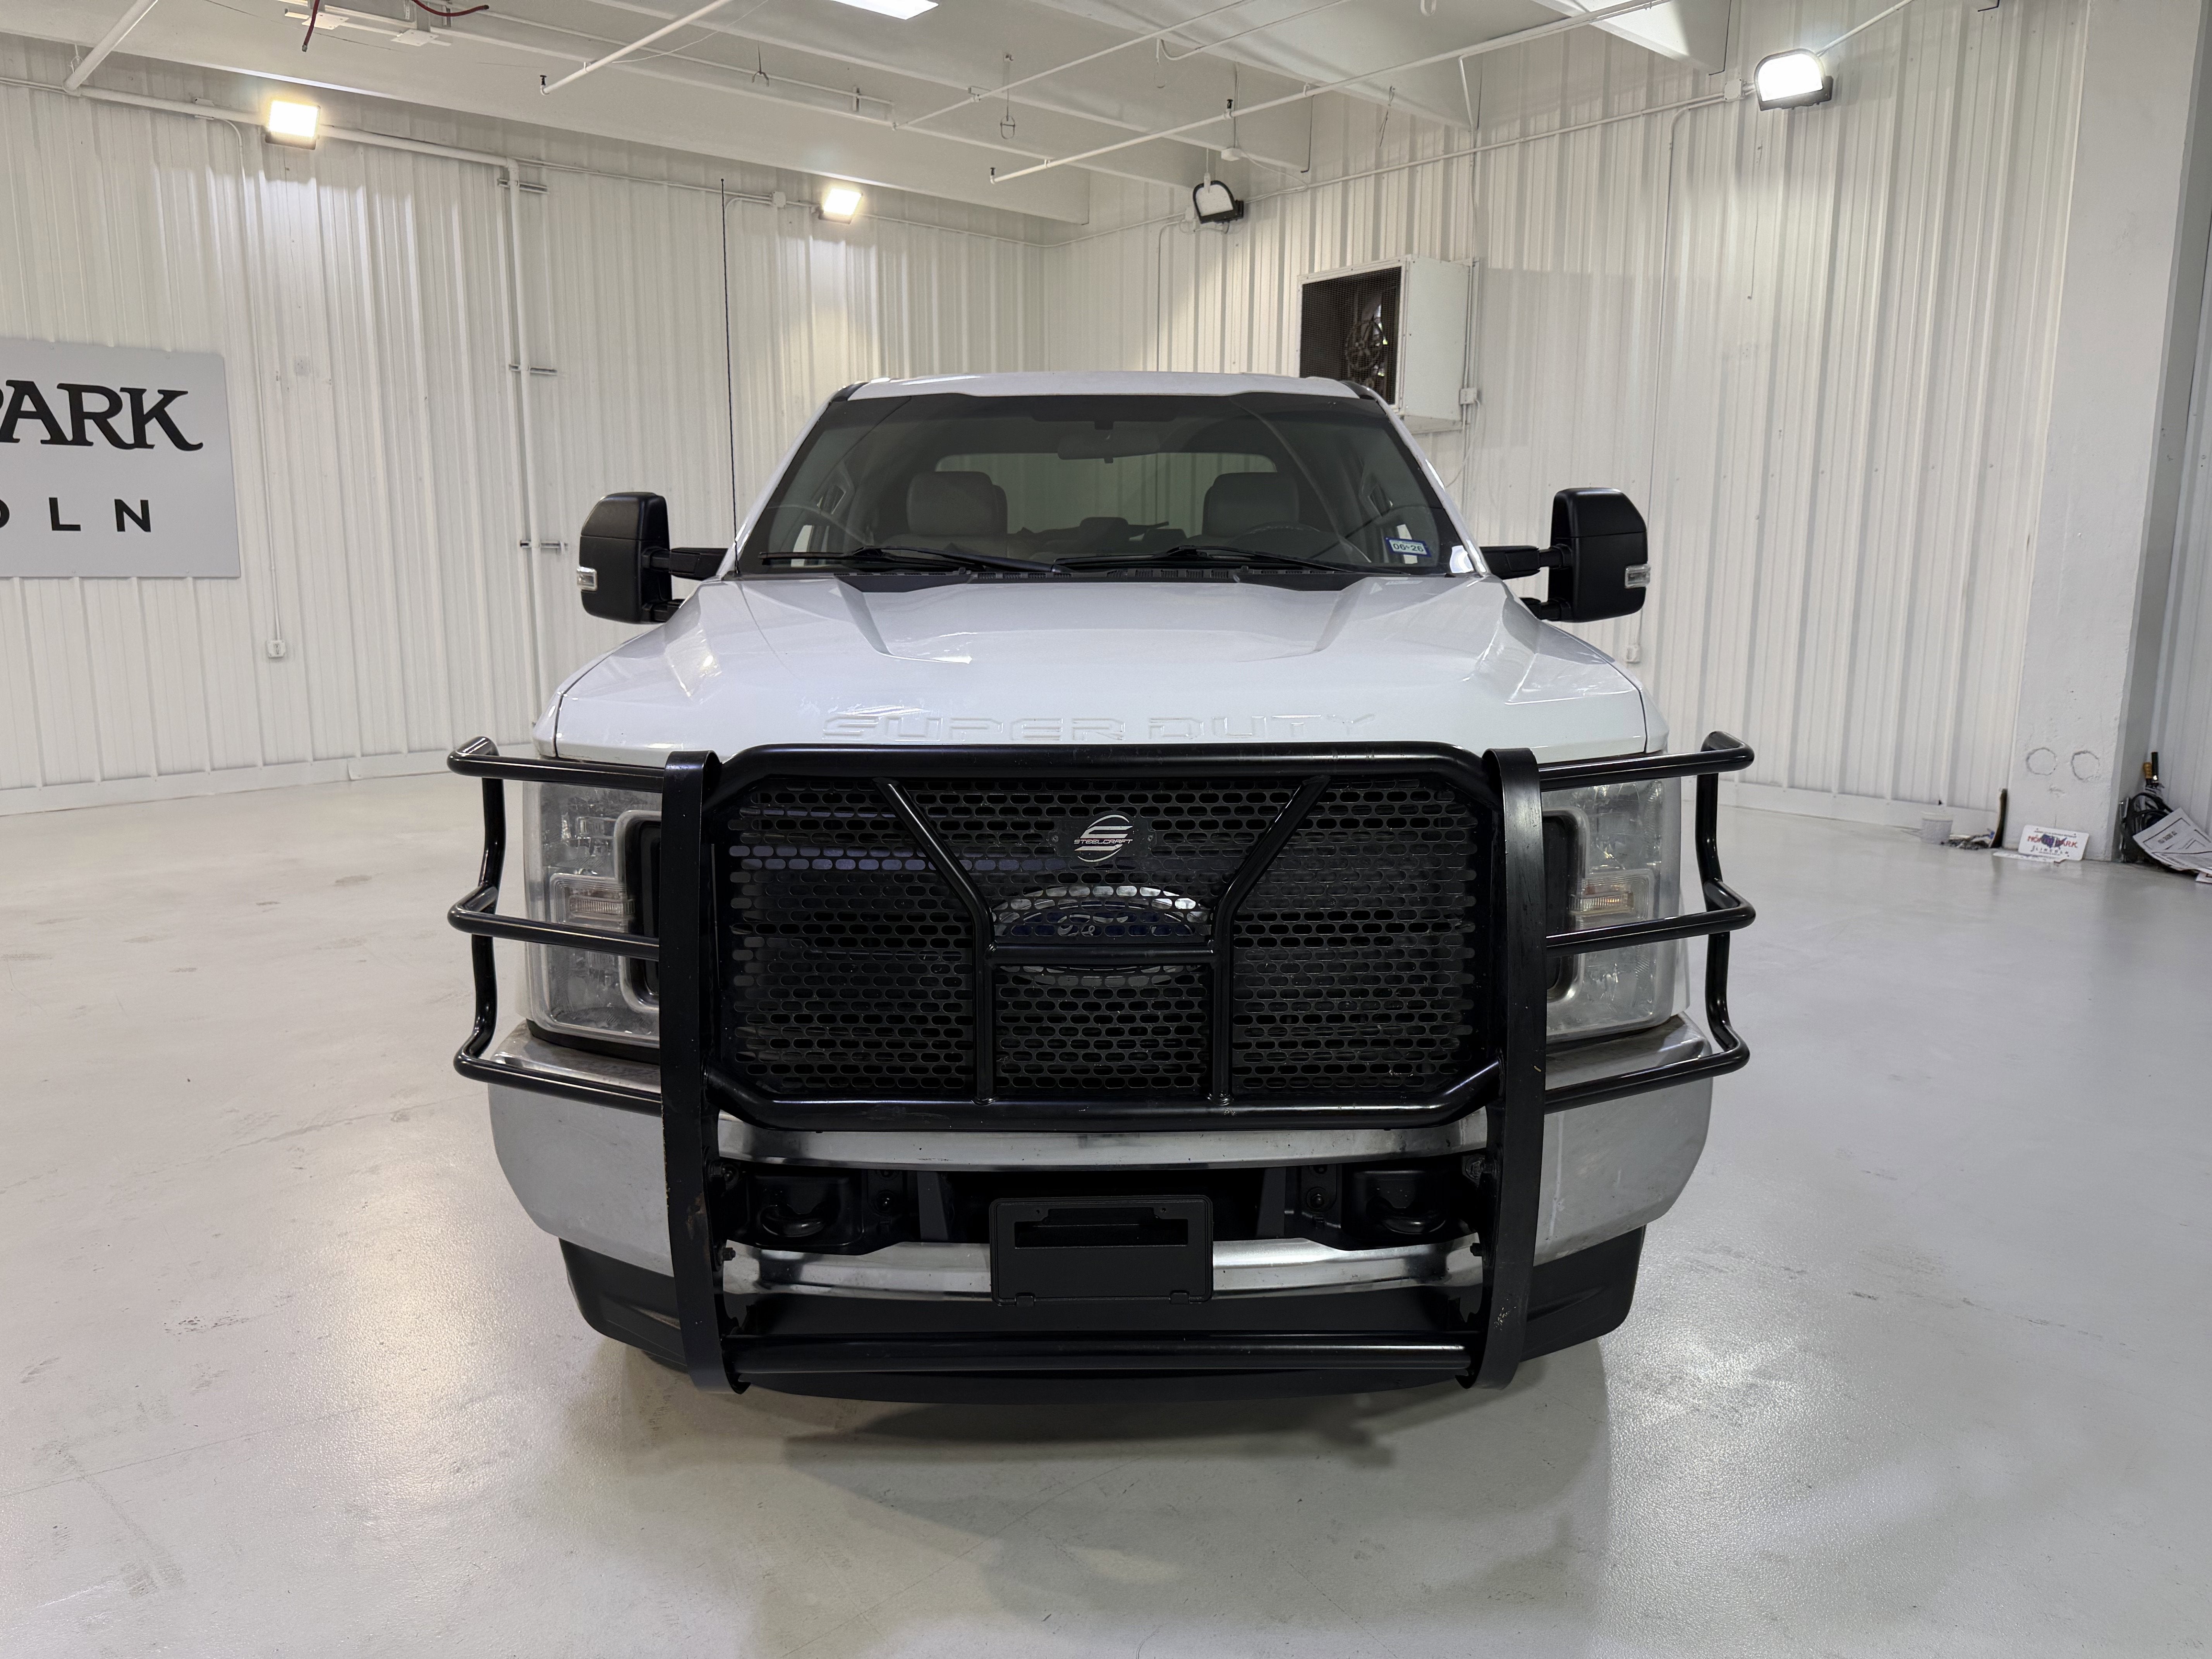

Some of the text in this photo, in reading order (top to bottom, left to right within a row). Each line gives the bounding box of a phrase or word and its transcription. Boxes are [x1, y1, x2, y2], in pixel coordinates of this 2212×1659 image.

[0, 380, 203, 451] ARK
[822, 714, 1376, 741] SUPER DUTY
